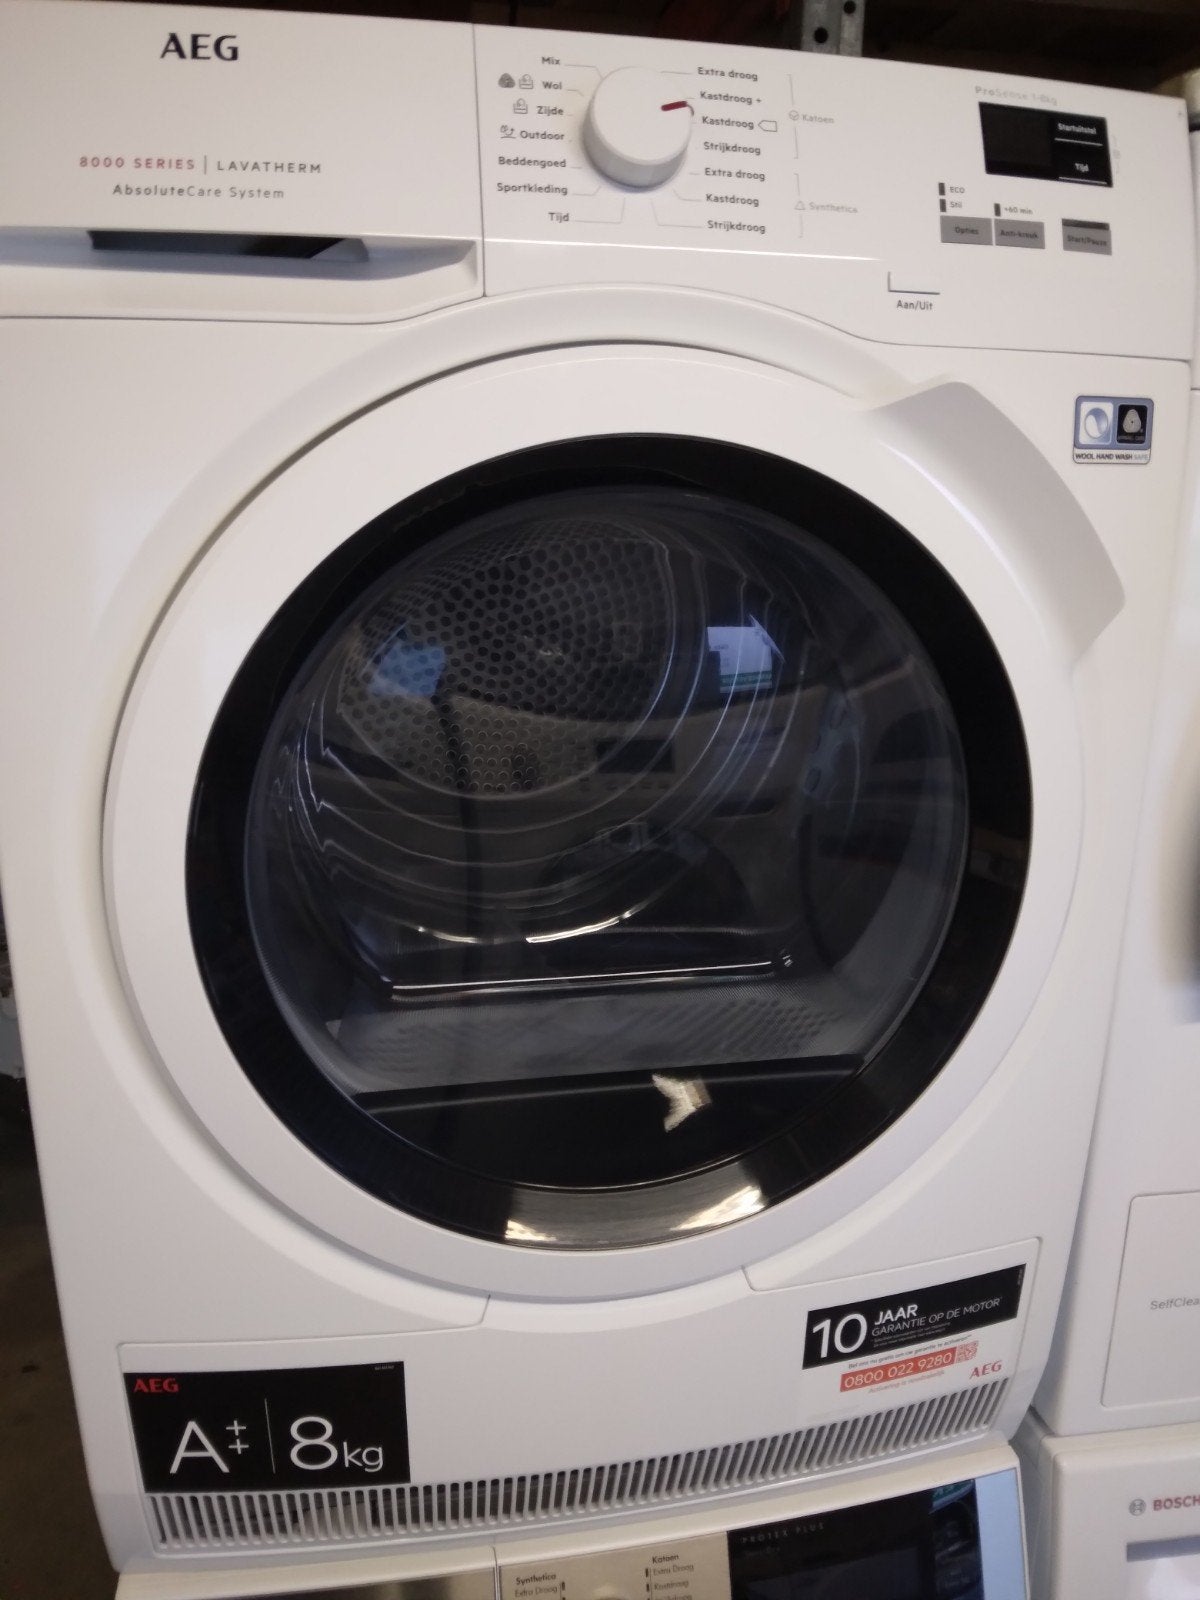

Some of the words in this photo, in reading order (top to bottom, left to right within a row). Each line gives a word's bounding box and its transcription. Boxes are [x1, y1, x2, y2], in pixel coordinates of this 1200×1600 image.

[160, 32, 239, 61] AEG
[541, 57, 561, 66] Mix
[698, 67, 726, 78] Extra
[728, 70, 758, 82] droog
[542, 80, 563, 90] Wol
[700, 91, 753, 105] Kastdroog
[536, 105, 564, 116] Zijde
[702, 116, 754, 130] Kastdroog
[802, 113, 835, 124] Katoen
[520, 130, 565, 141] Outdoor
[703, 141, 761, 156] Strijkdroog
[79, 156, 125, 169] 8000
[133, 158, 195, 170] SERIES
[217, 161, 322, 174] LAVATHERM
[498, 156, 567, 169] Beddengoed
[704, 167, 732, 178] Extra
[735, 169, 765, 182] droog
[112, 184, 222, 198] AbsoluteCare
[229, 187, 285, 200] System
[496, 182, 568, 196] Sportkleding
[949, 186, 966, 194] ECO
[705, 194, 759, 207] Kastdroog
[549, 212, 570, 223] Tijd
[707, 220, 766, 234] Strijkdroog
[896, 299, 933, 311] Aan/Uit
[1075, 452, 1095, 460] WOOL
[1096, 452, 1115, 460] HAND
[874, 1304, 919, 1326] JAAR
[871, 1316, 927, 1337] GARANTIE
[928, 1312, 945, 1324] OP
[946, 1308, 961, 1320] DE
[812, 1313, 867, 1358] 10
[844, 1370, 884, 1389] 0800
[887, 1362, 914, 1379] 022
[917, 1352, 953, 1371] 9280
[968, 1360, 1003, 1380] AEG
[133, 1378, 180, 1394] AEG
[1153, 1495, 1200, 1511] BOSCH
[652, 1554, 680, 1565] Katoen
